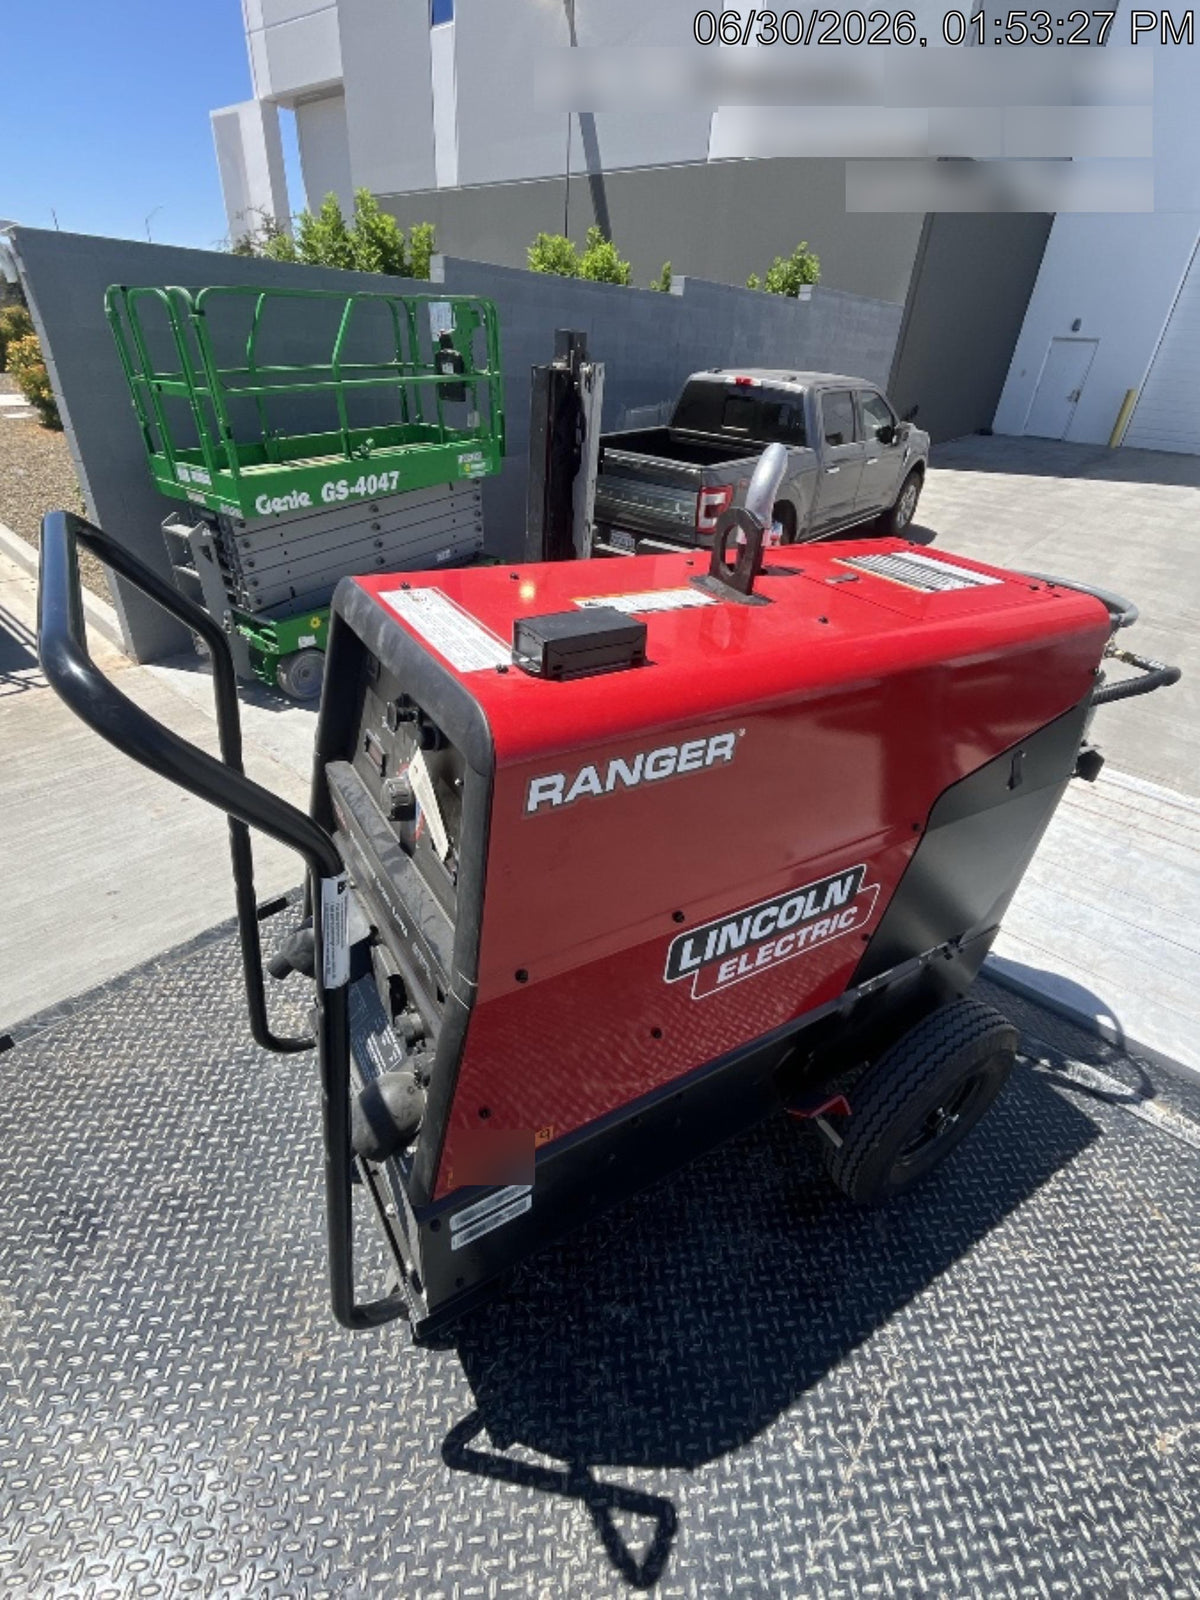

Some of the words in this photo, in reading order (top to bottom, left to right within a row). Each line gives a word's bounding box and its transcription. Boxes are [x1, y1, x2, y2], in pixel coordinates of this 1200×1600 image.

[255, 489, 313, 515] Genie
[321, 470, 400, 503] GS-4047
[526, 731, 737, 812] RANGER
[678, 874, 855, 972] LINCOLN
[716, 905, 859, 984] ELECTRIC
